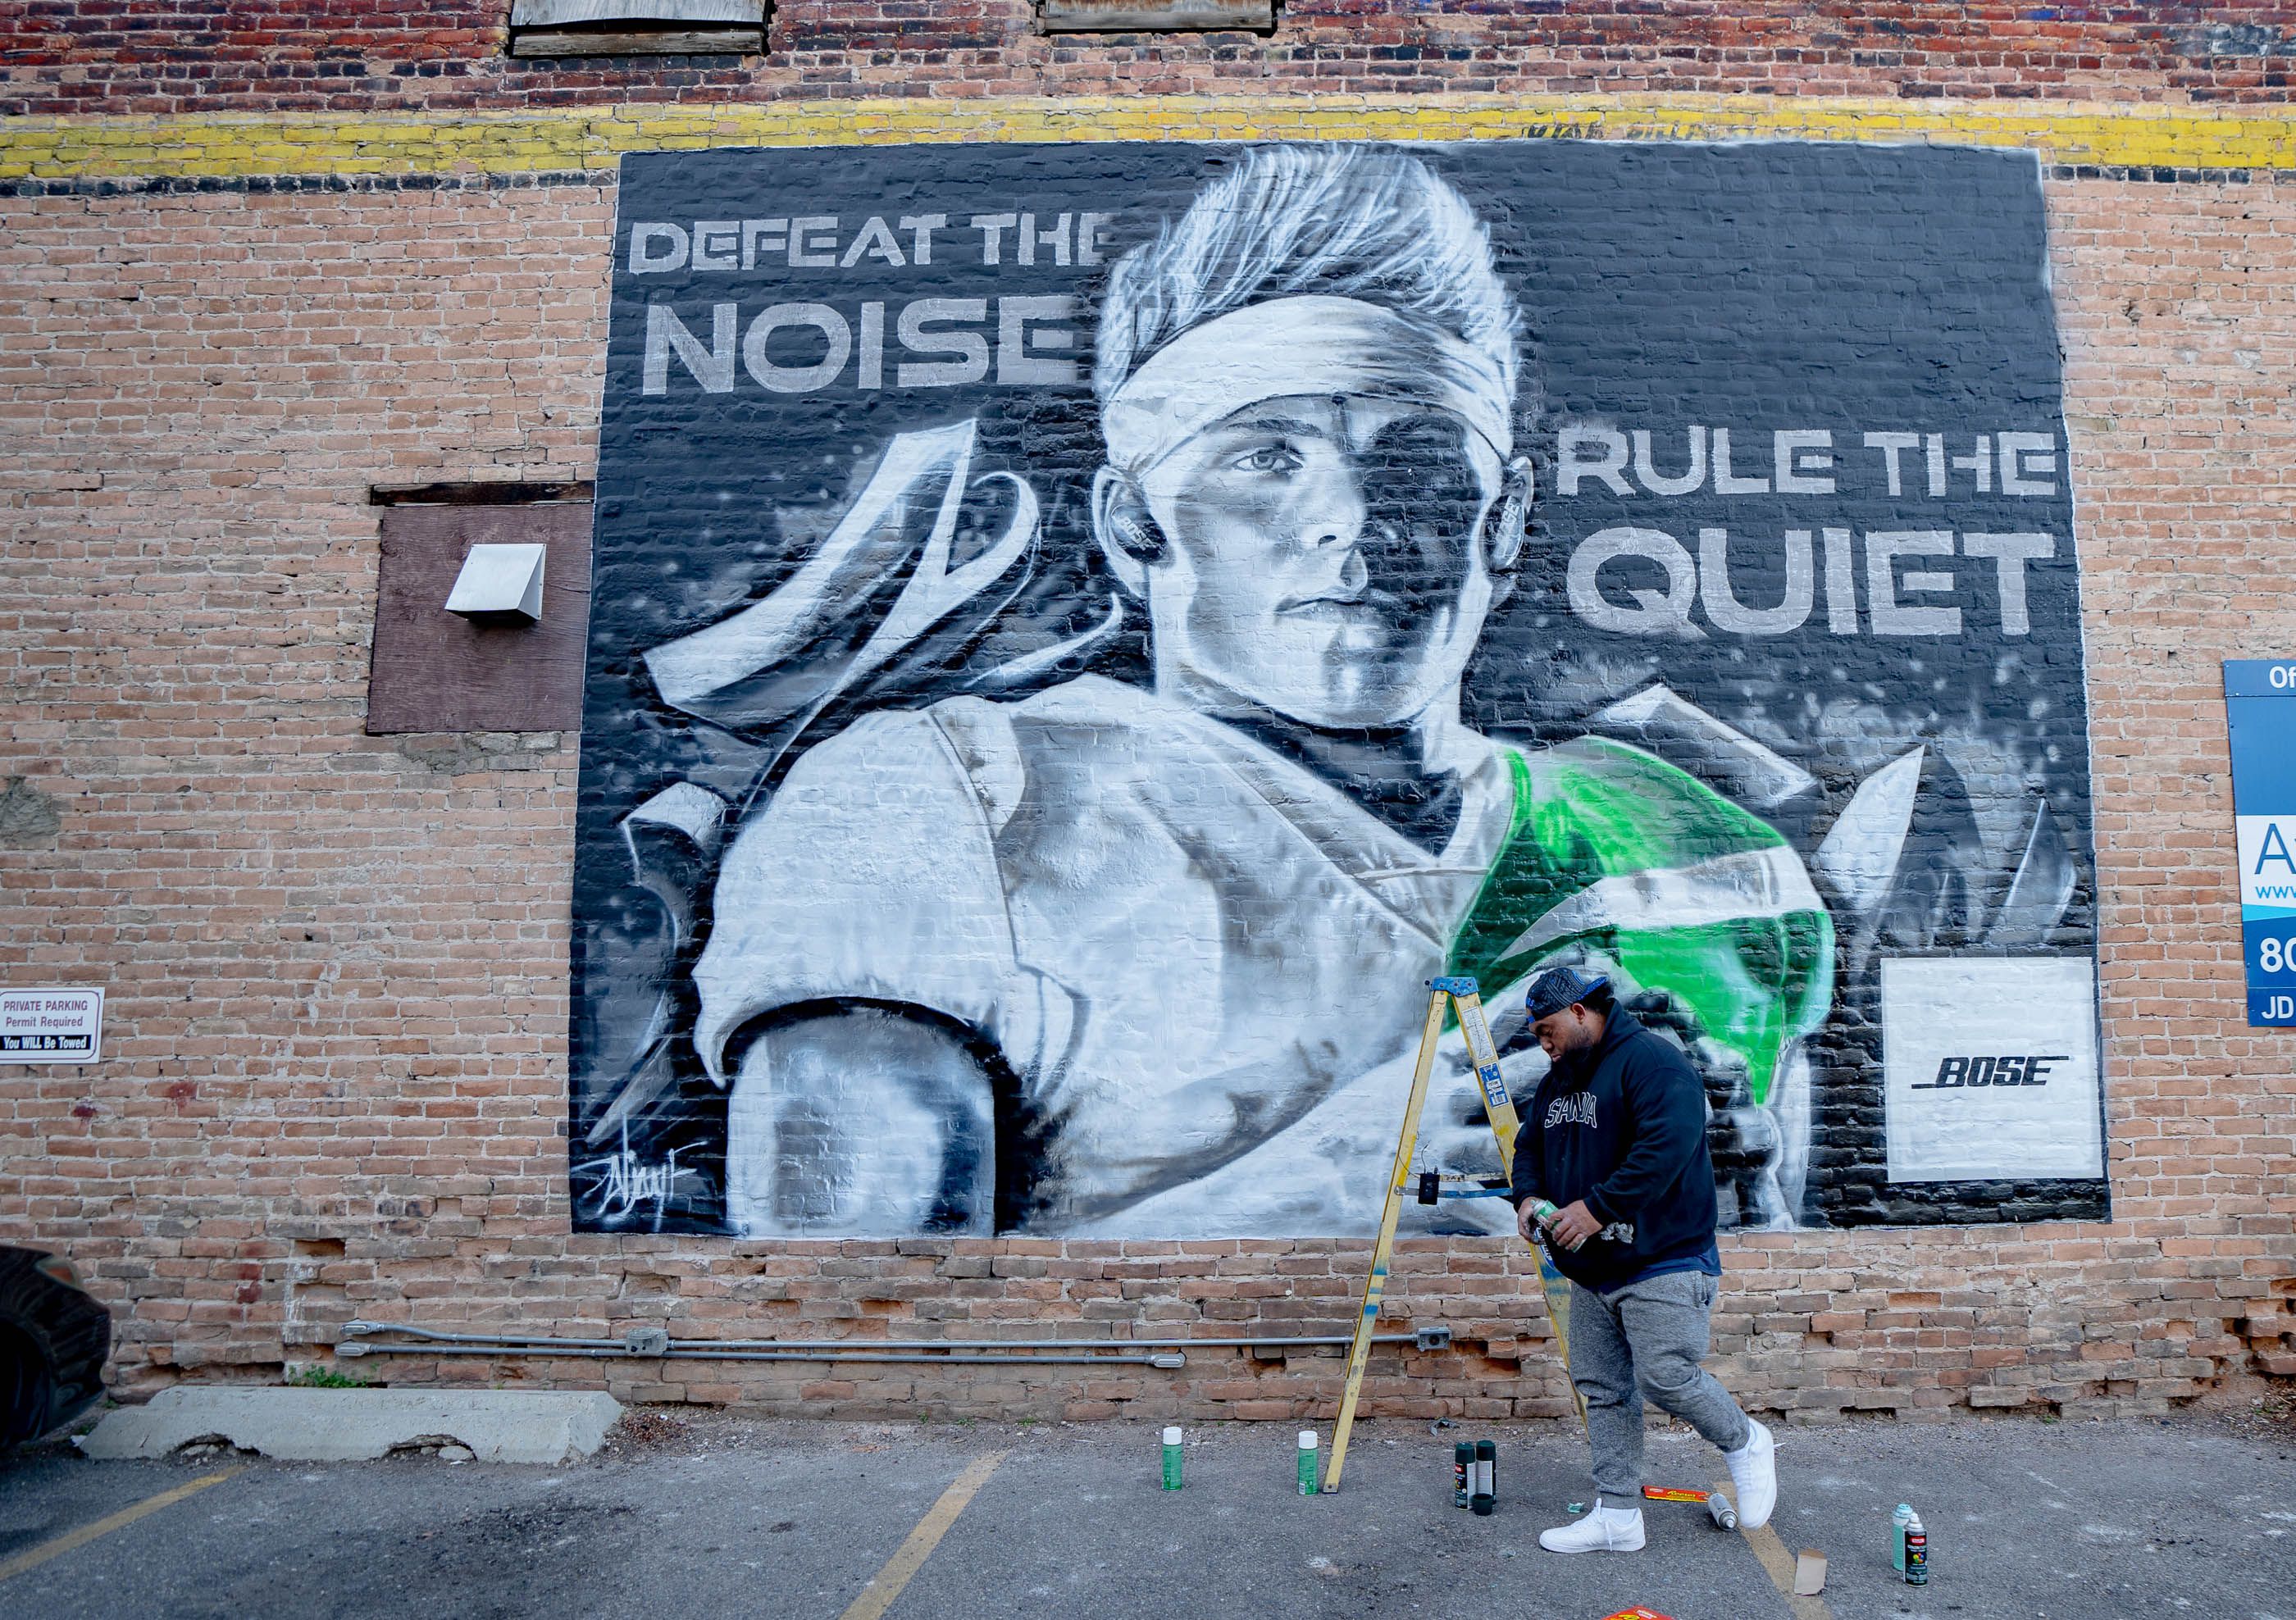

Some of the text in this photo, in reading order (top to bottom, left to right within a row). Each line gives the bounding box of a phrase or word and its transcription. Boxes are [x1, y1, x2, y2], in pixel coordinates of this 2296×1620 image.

[629, 212, 1115, 273] DEFEAT THE
[642, 295, 1077, 395] NOISE
[1556, 425, 2056, 497] RULE THE
[1566, 526, 2055, 638] QUIET
[2253, 823, 2296, 875] A
[3, 1000, 88, 1011] PRIVATE PARKING
[6, 1017, 83, 1028] Permit Required
[2261, 995, 2294, 1019] JD
[4, 1036, 87, 1049] You WILL Be Towed
[1911, 1055, 2070, 1090] BOSE
